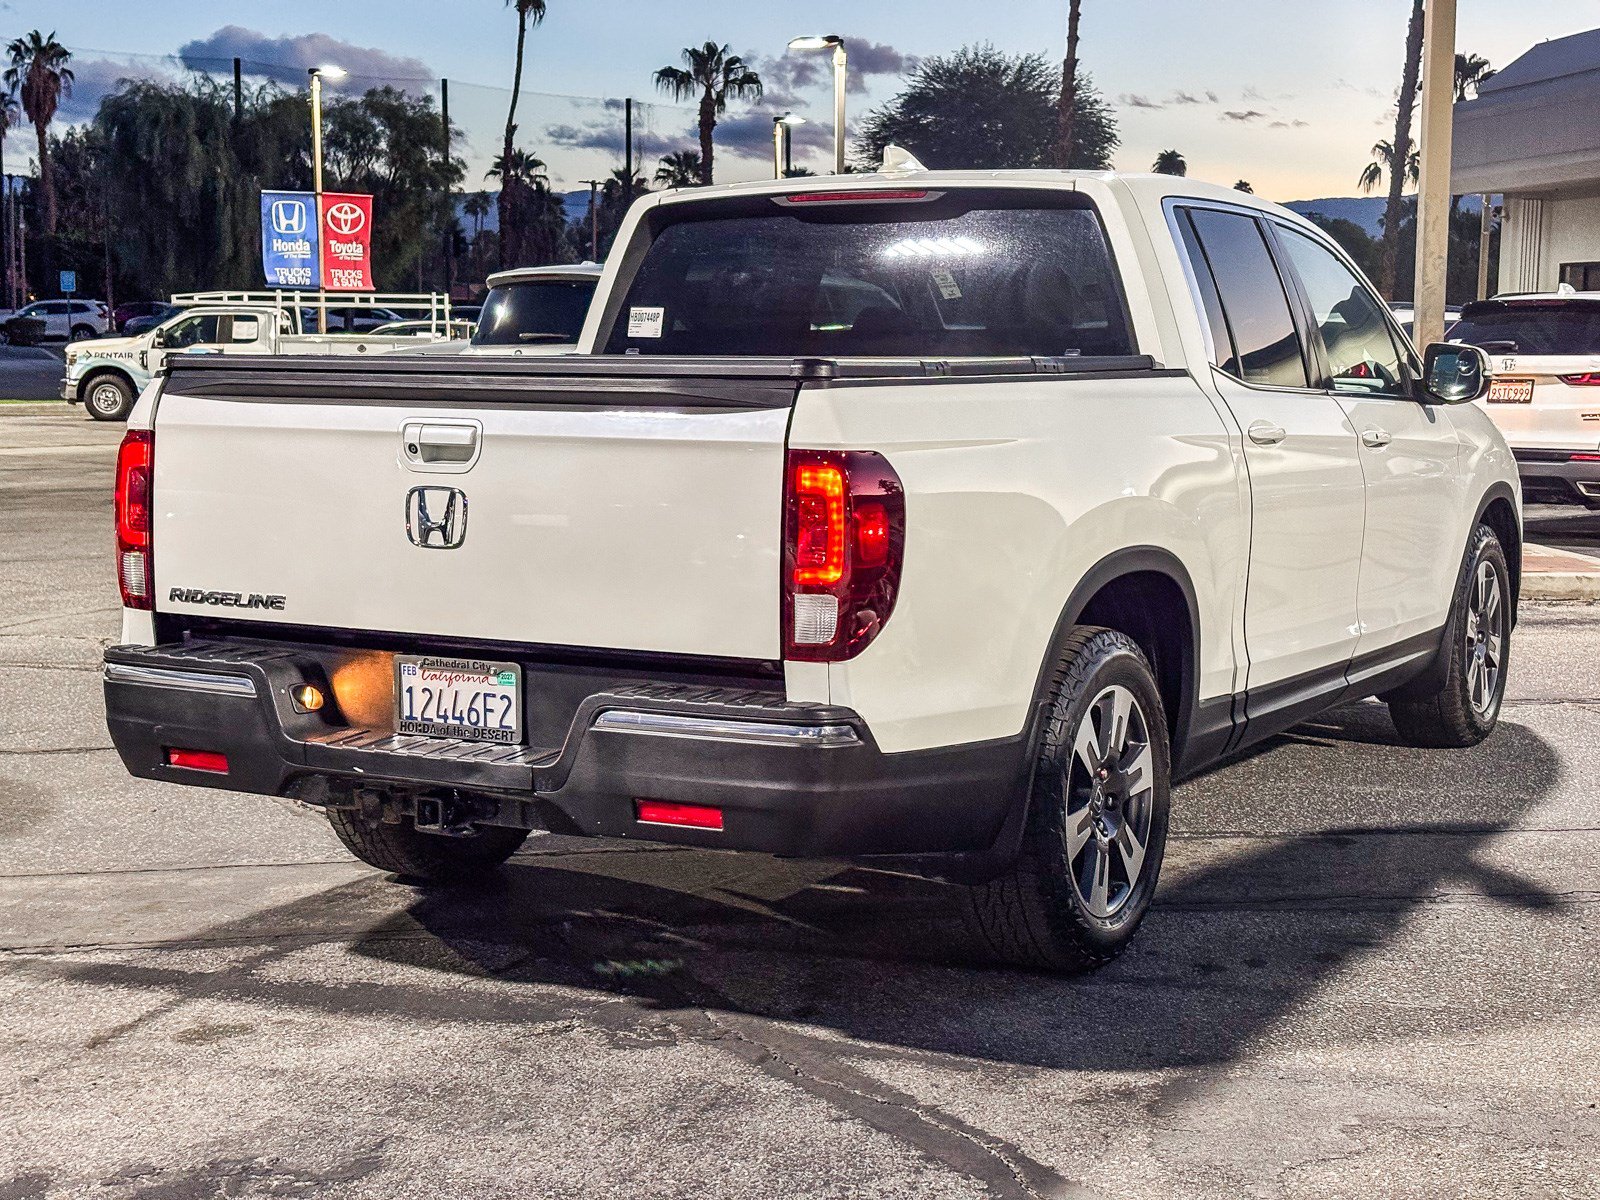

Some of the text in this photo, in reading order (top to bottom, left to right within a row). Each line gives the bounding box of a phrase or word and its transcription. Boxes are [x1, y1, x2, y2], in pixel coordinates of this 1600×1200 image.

[272, 239, 311, 252] Honda
[329, 240, 363, 253] Toyota
[274, 267, 312, 277] TRUCKS
[330, 269, 363, 278] TRUCKS
[279, 276, 311, 285] & SUVs
[333, 278, 363, 287] & SUVs
[1490, 388, 1530, 401] 9STC999
[168, 587, 287, 610] RIDGELINE
[402, 665, 417, 676] FEB
[423, 657, 491, 672] Cathedral City
[421, 669, 490, 688] California
[404, 685, 513, 730] 12446F2
[440, 726, 449, 735] of
[453, 726, 471, 738] the
[473, 728, 516, 741] DESERT
